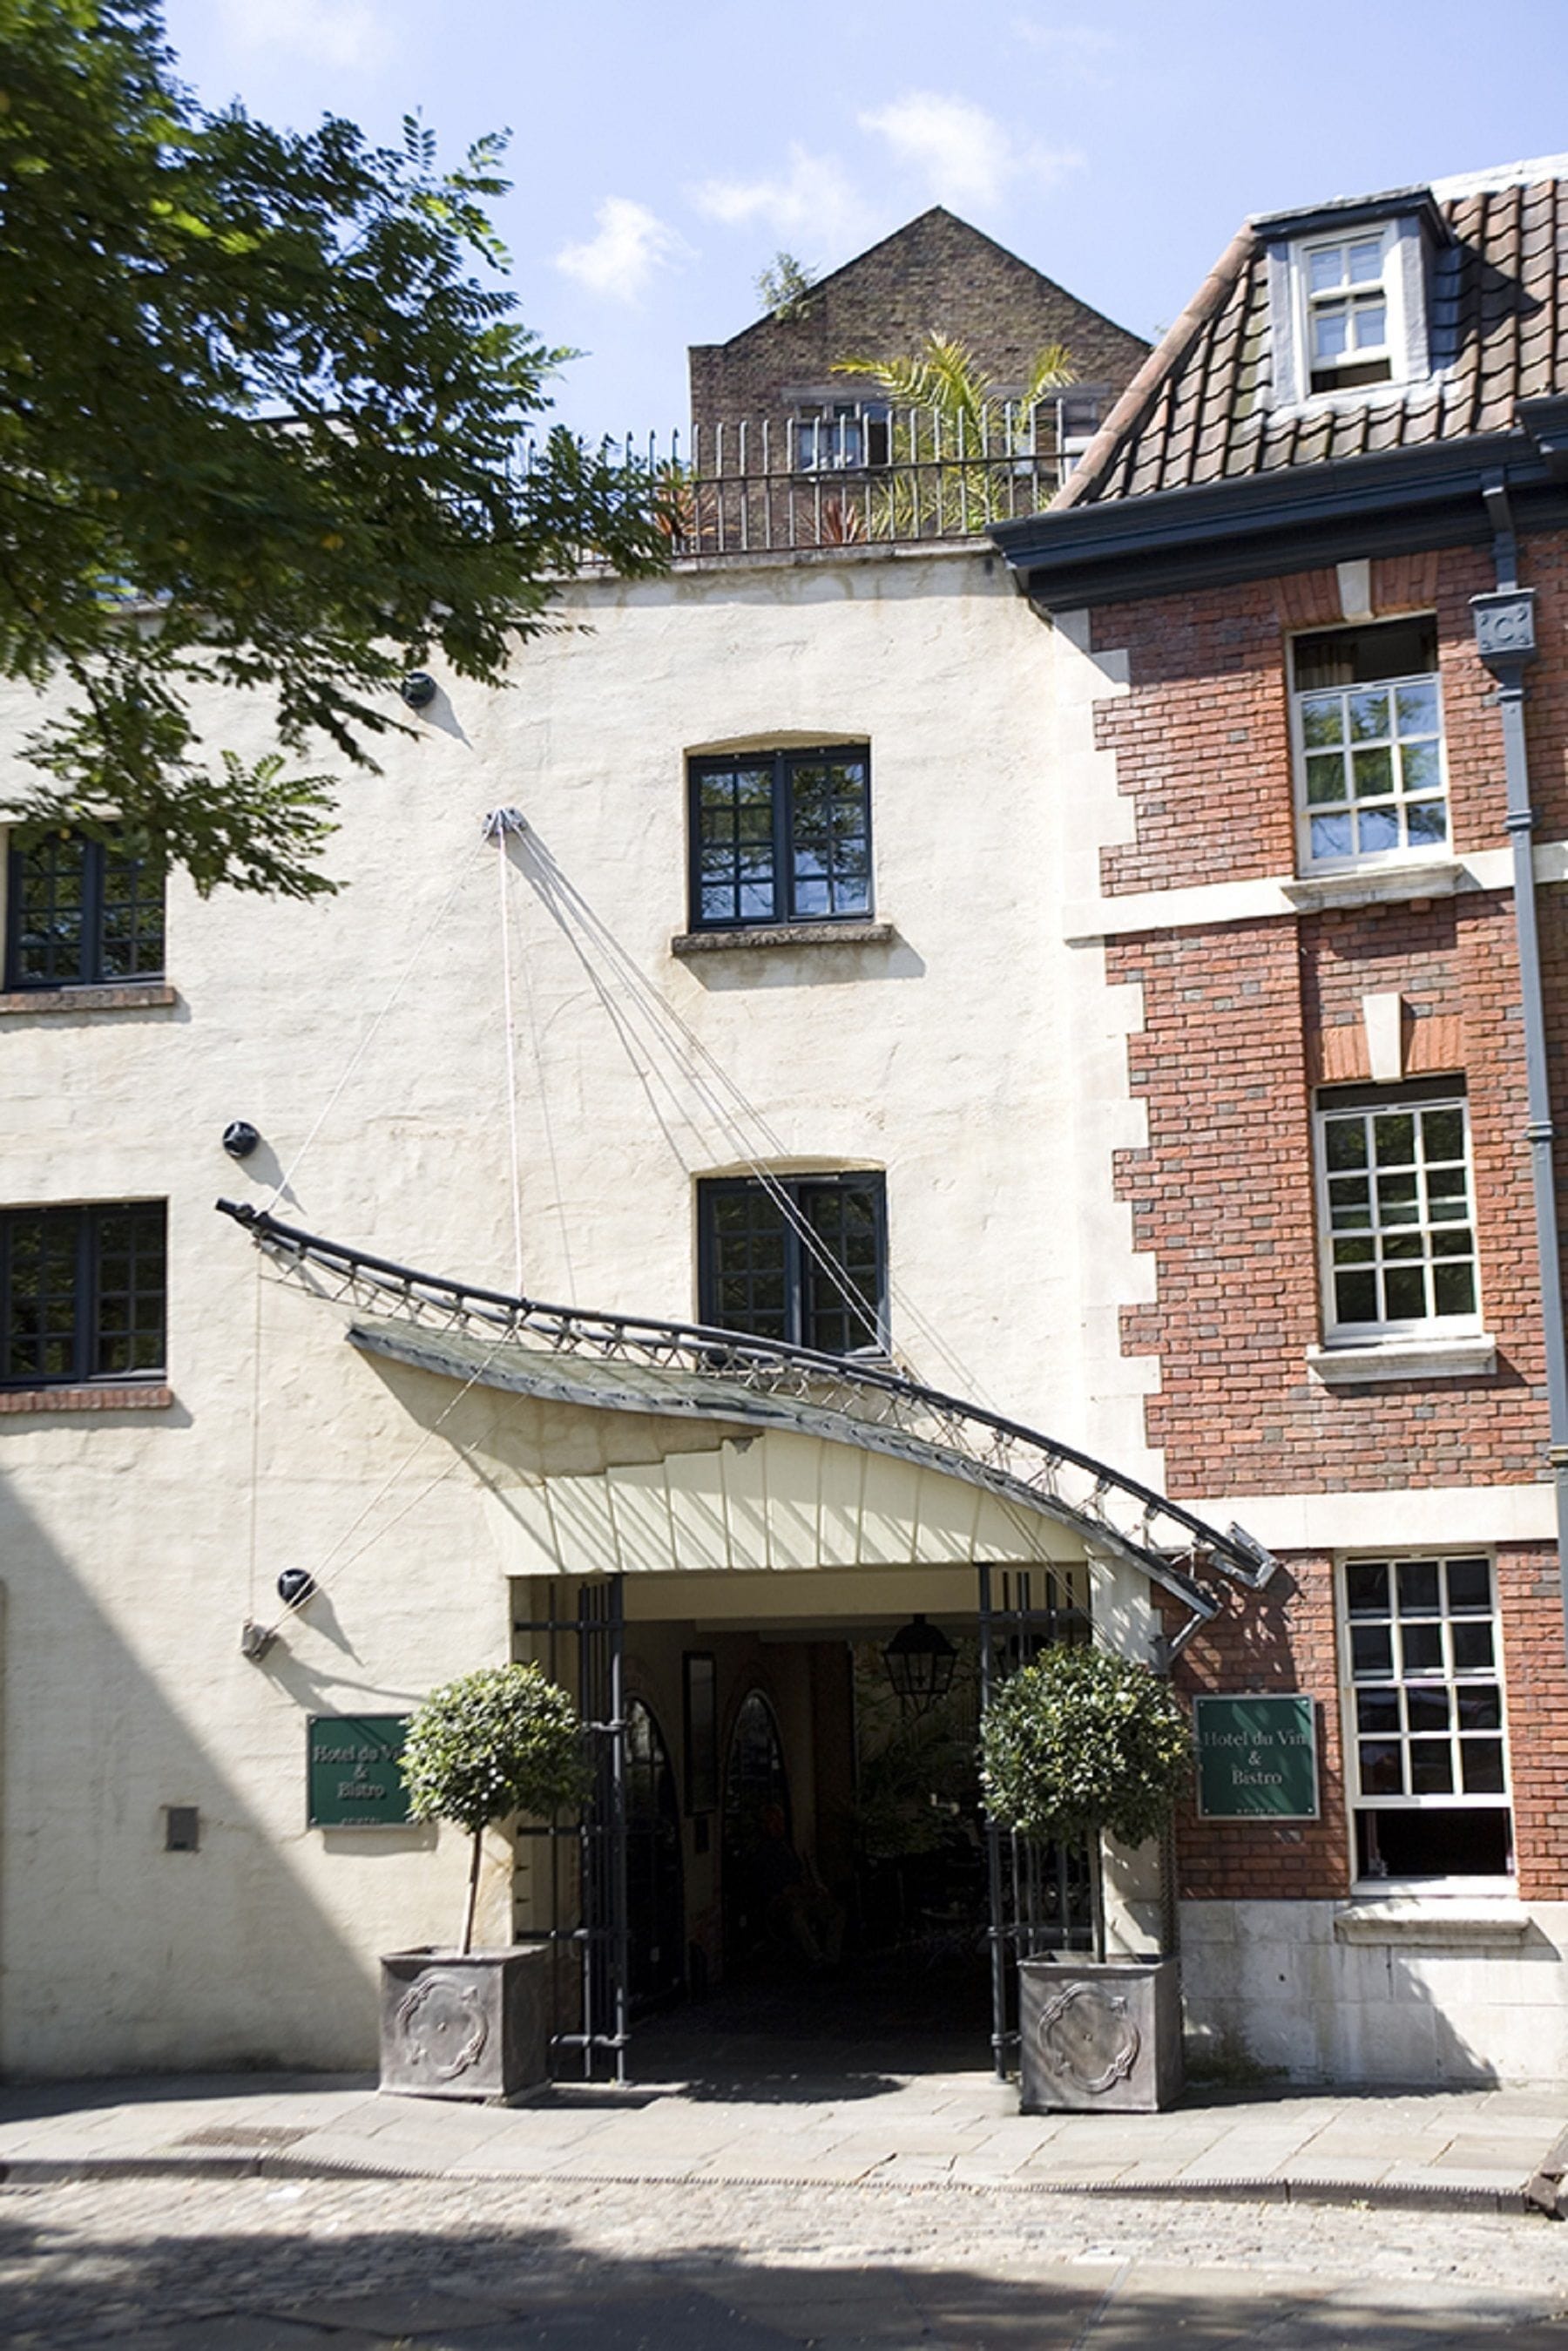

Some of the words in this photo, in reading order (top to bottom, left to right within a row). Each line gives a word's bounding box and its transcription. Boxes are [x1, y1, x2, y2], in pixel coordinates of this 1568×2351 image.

[1204, 1731, 1248, 1746] Hotel
[1252, 1731, 1274, 1746] du
[1277, 1730, 1308, 1745] Vin
[313, 1744, 355, 1762] Hotel
[357, 1744, 378, 1762] du
[1247, 1751, 1261, 1766] &
[354, 1763, 368, 1779] &
[1233, 1769, 1282, 1785] Bistro
[336, 1781, 385, 1799] Bistro
